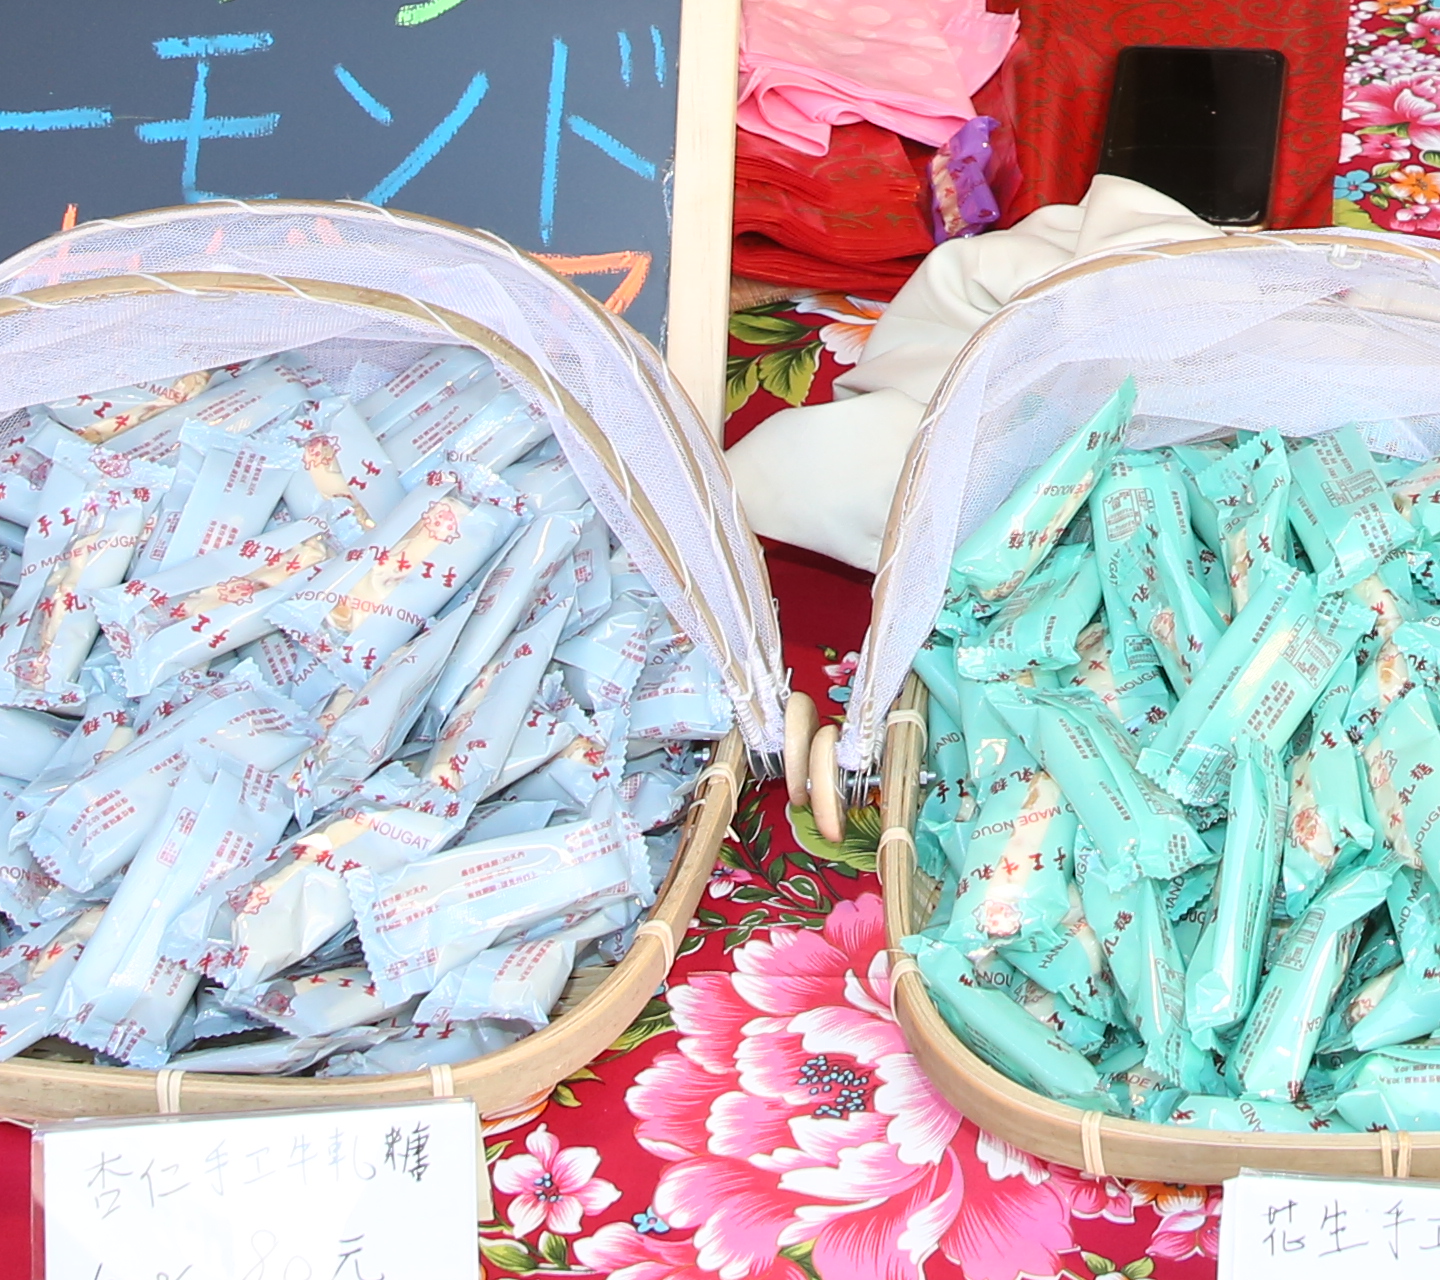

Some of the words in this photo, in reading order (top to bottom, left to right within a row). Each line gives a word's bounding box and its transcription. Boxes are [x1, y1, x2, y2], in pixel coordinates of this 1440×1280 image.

[351, 596, 394, 618] MADE
[1018, 805, 1062, 827] MADE
[369, 816, 433, 852] NOUGAT
